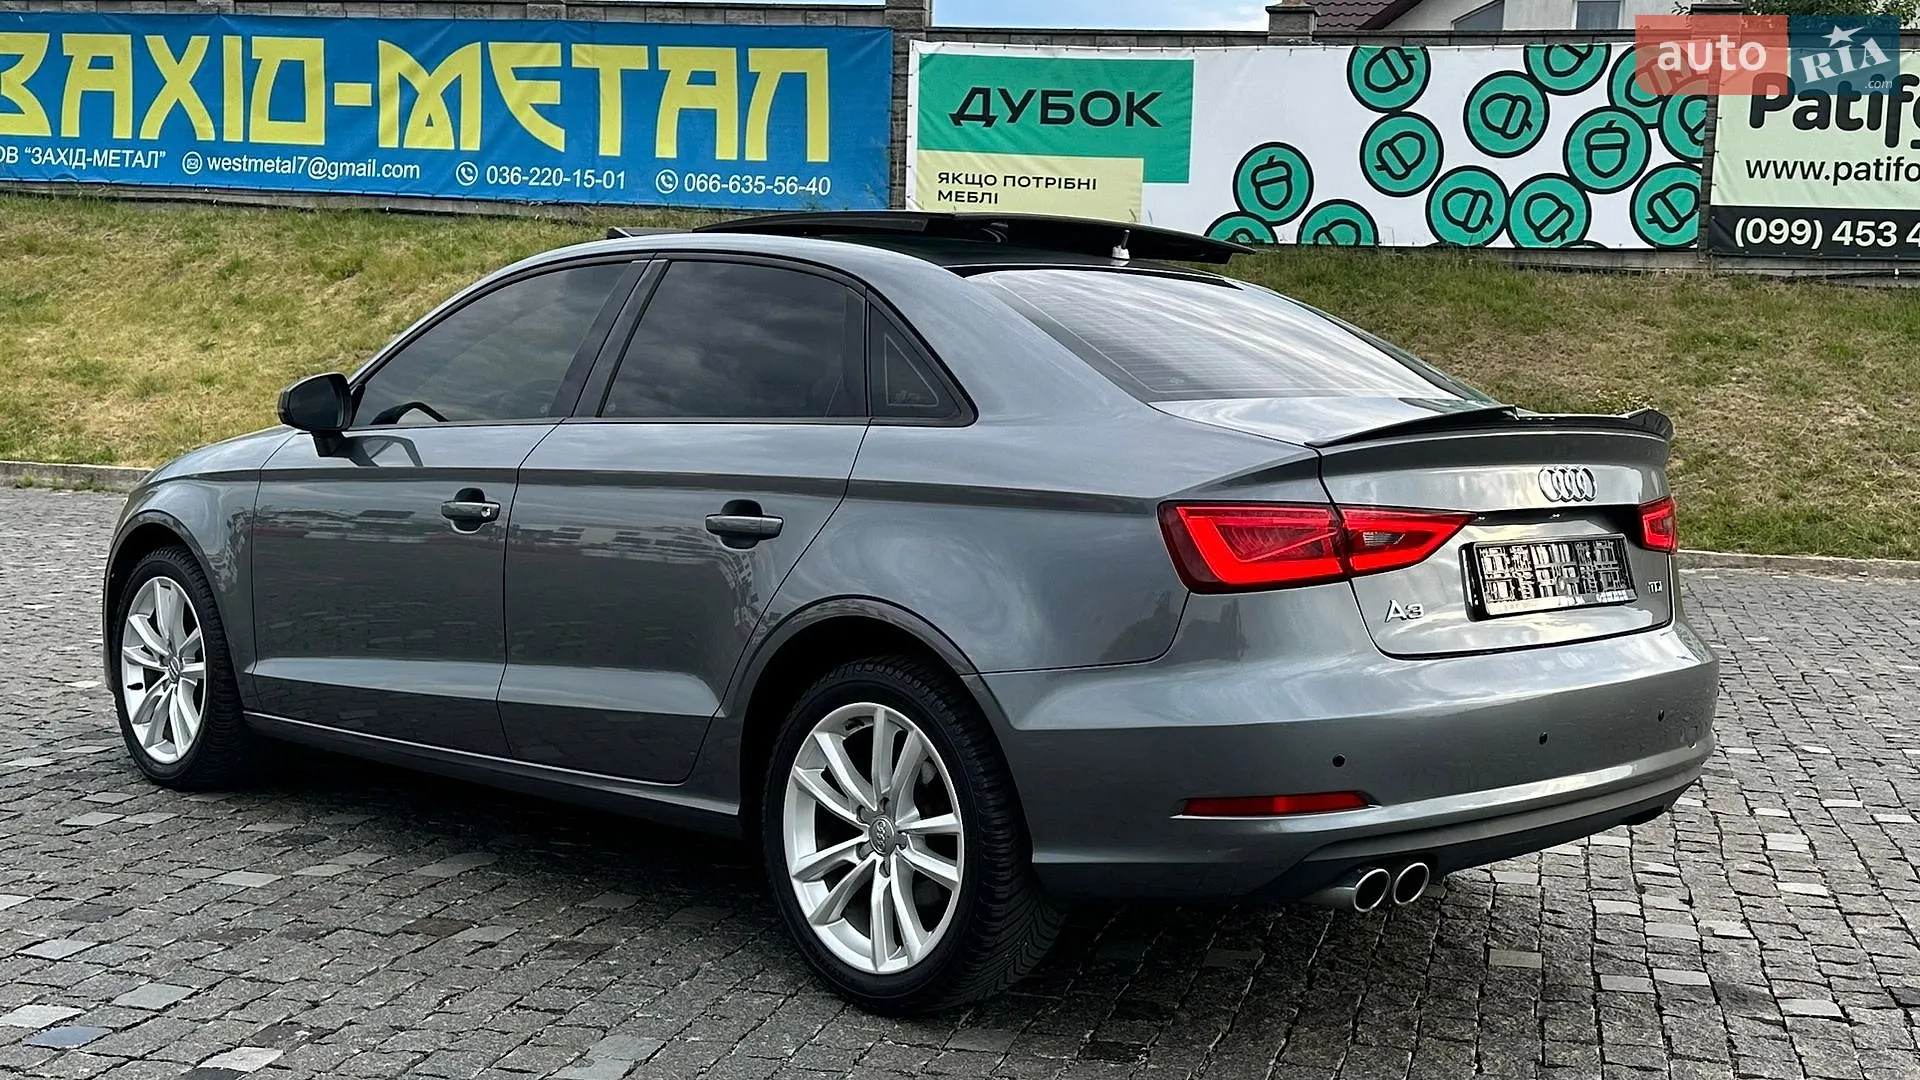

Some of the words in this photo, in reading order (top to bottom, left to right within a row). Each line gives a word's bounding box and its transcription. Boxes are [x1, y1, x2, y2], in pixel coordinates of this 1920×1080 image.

[948, 87, 1163, 128] ДУБОК
[1749, 72, 1920, 149] Patif
[207, 155, 420, 180] westmetal7@gmail.com
[486, 166, 626, 189] 036-220-15-01
[684, 174, 831, 196] 066-635-56-40
[937, 172, 997, 188] ЯКЩО
[1003, 176, 1097, 190] ПОТРІБНІ
[937, 190, 998, 204] МЕБЛІ
[1735, 217, 1823, 249] (099)
[1832, 220, 1897, 247] 453
[1385, 599, 1425, 622] A3
